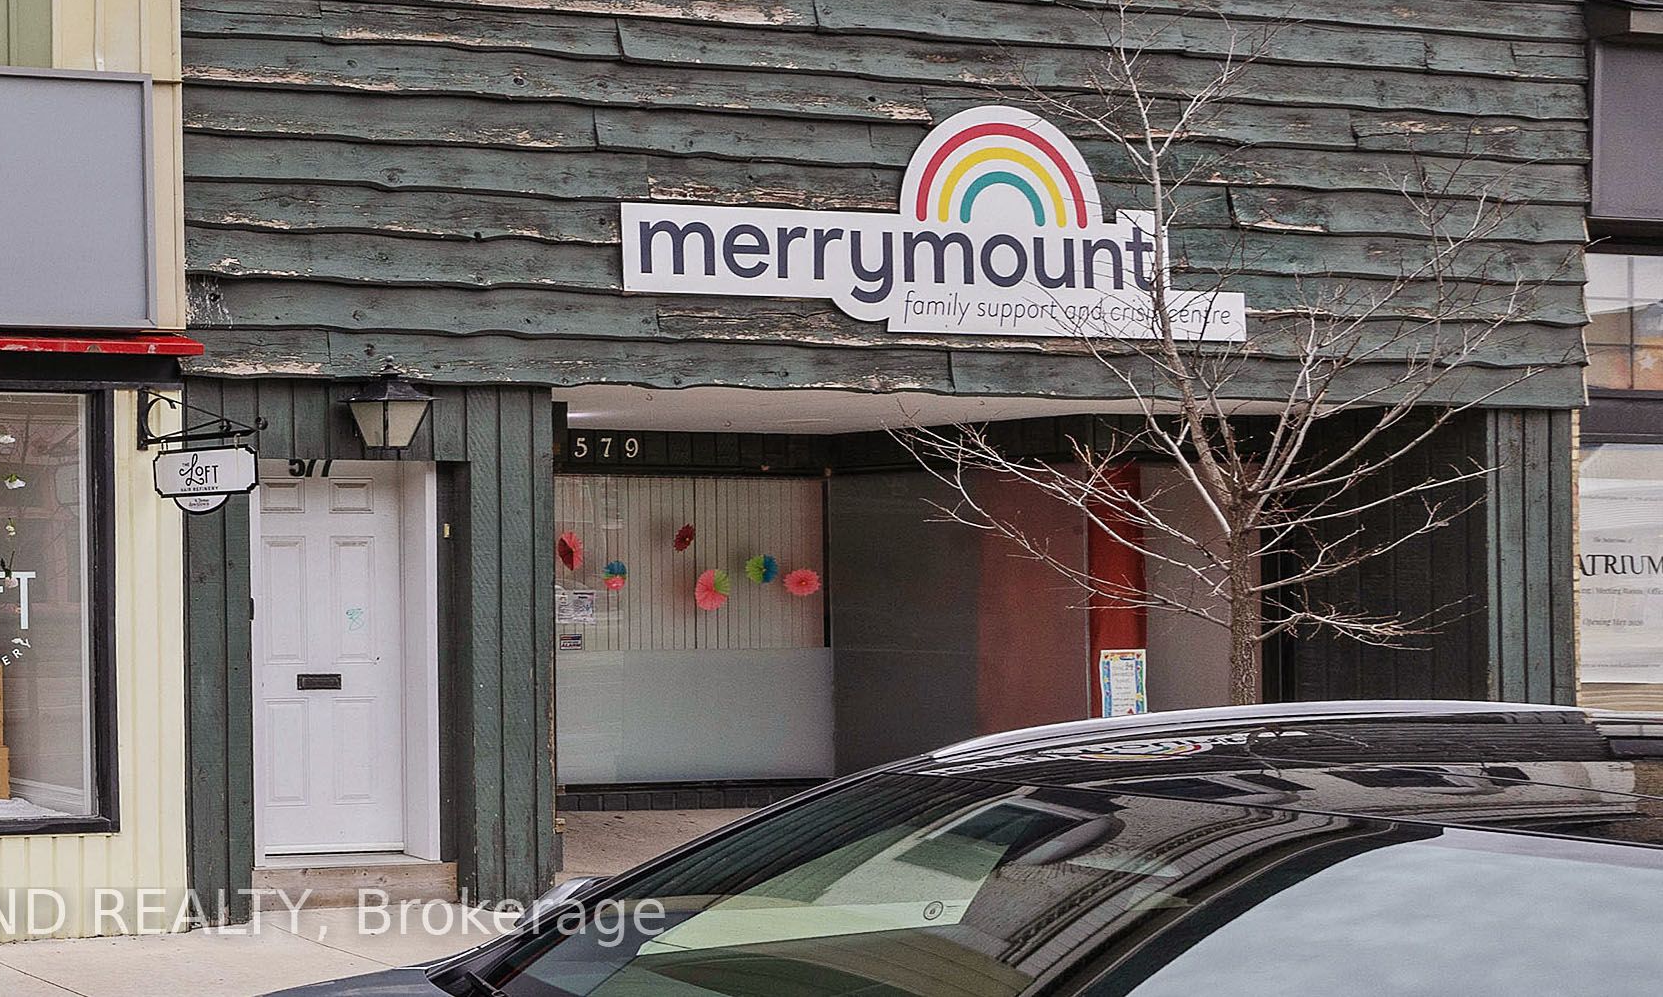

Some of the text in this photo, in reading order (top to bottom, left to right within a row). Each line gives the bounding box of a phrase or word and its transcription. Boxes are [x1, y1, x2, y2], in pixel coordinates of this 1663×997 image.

[639, 219, 1154, 301] merrymount
[904, 291, 971, 326] family
[977, 300, 1058, 327] support
[1066, 298, 1102, 321] and
[574, 437, 639, 458] 579
[179, 453, 219, 486] LOFT
